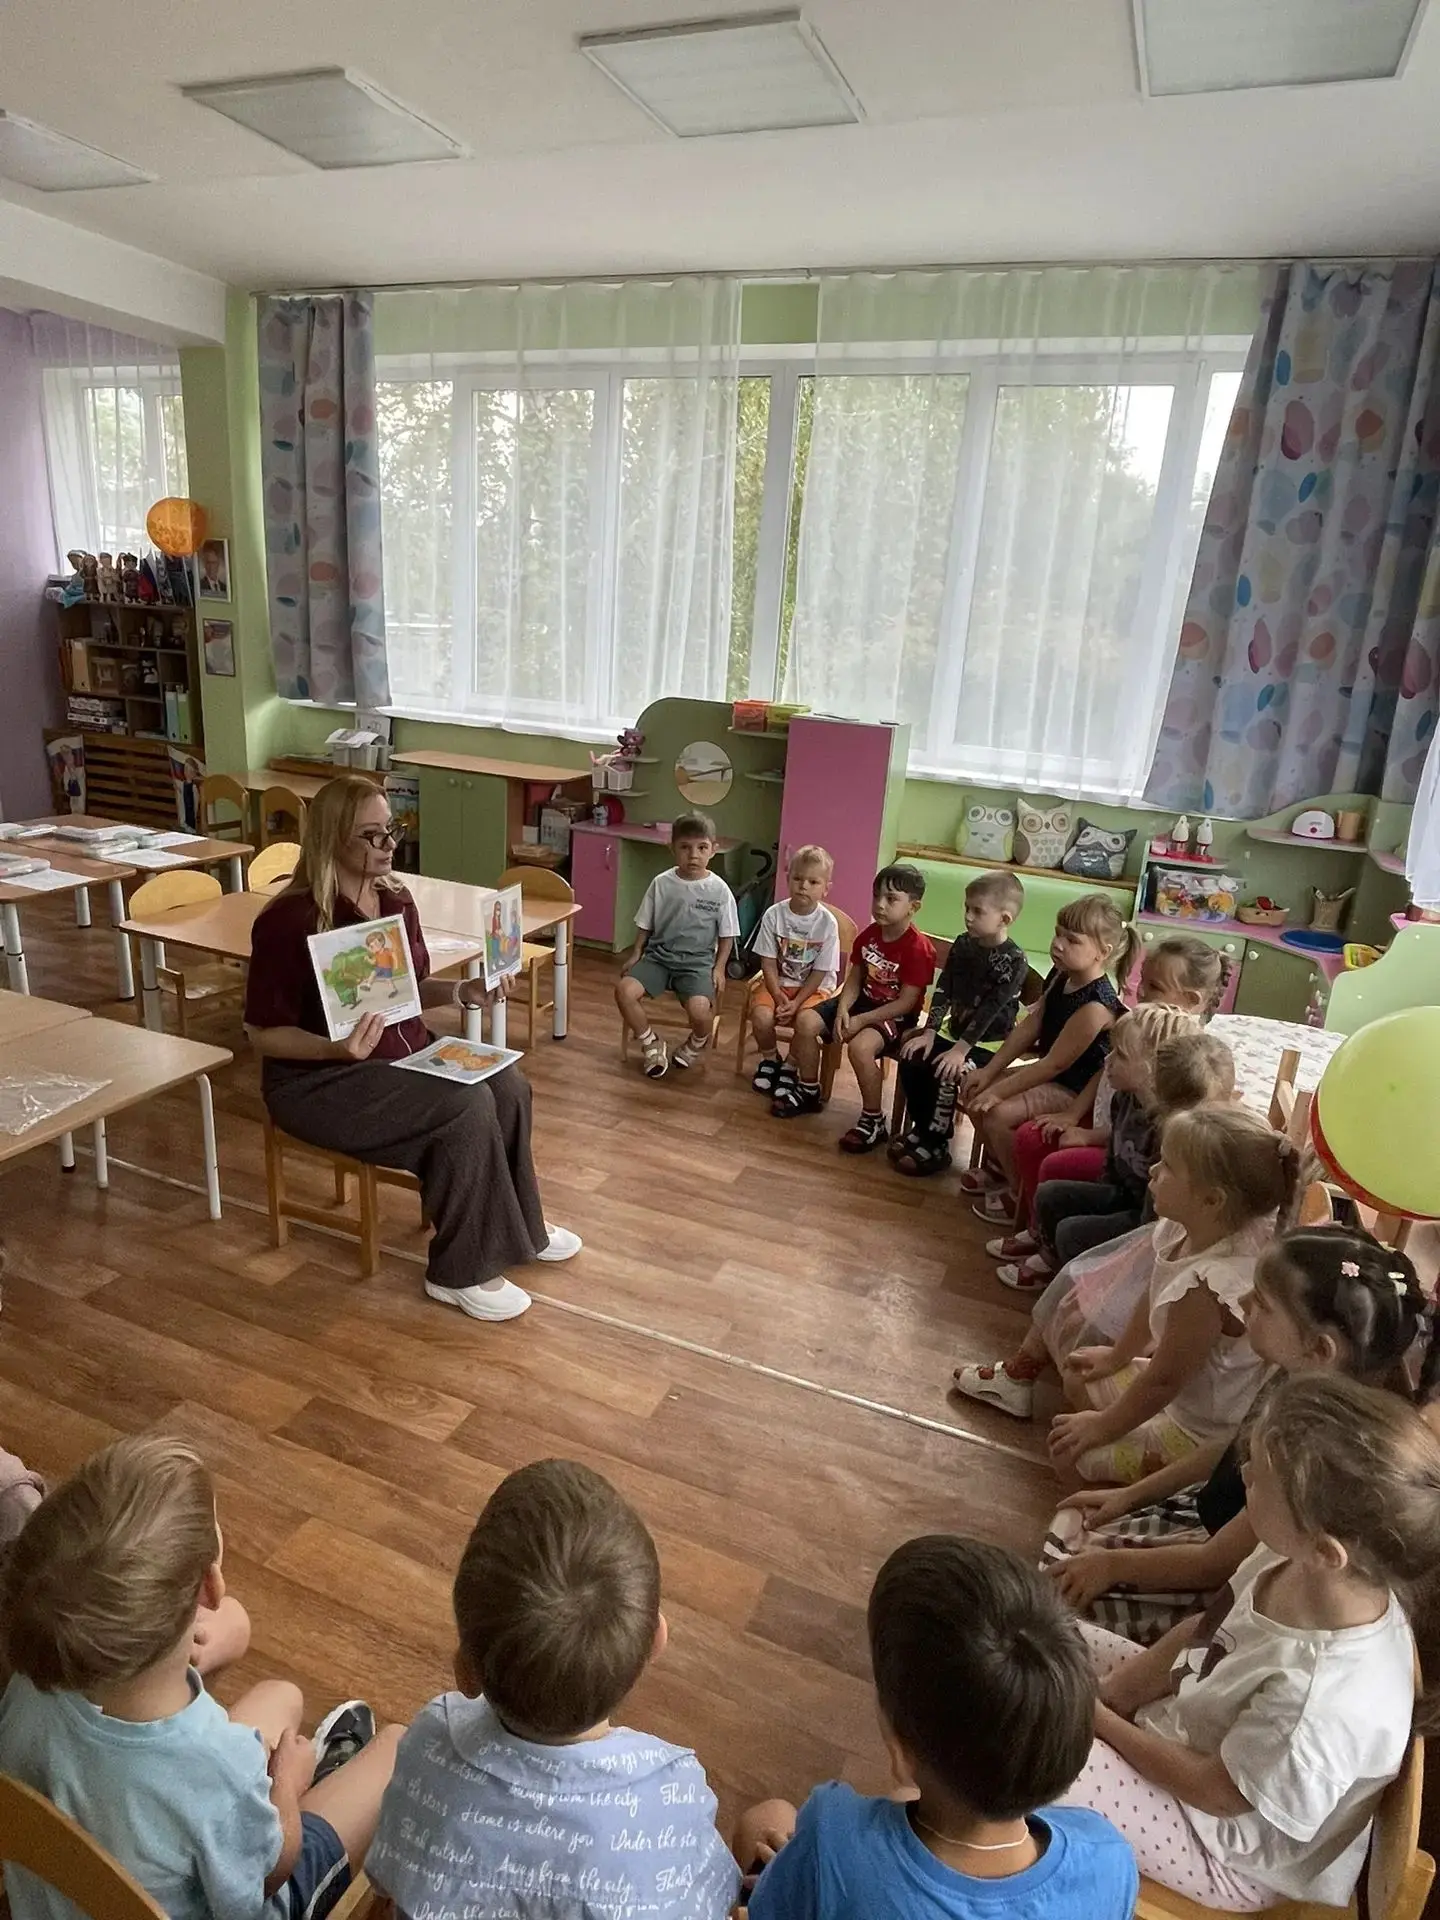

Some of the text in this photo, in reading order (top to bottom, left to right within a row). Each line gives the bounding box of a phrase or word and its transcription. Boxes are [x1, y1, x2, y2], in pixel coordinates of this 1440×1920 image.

[461, 1807, 504, 1829] Home
[507, 1819, 522, 1833] is
[525, 1815, 566, 1842] where
[567, 1832, 595, 1854] you
[610, 1828, 653, 1851] Under
[657, 1824, 677, 1849] the
[496, 1853, 535, 1888] Away
[539, 1859, 572, 1884] from
[579, 1866, 601, 1891] the
[604, 1873, 634, 1904] city
[413, 1901, 456, 1920] Under
[463, 1903, 486, 1920] the
